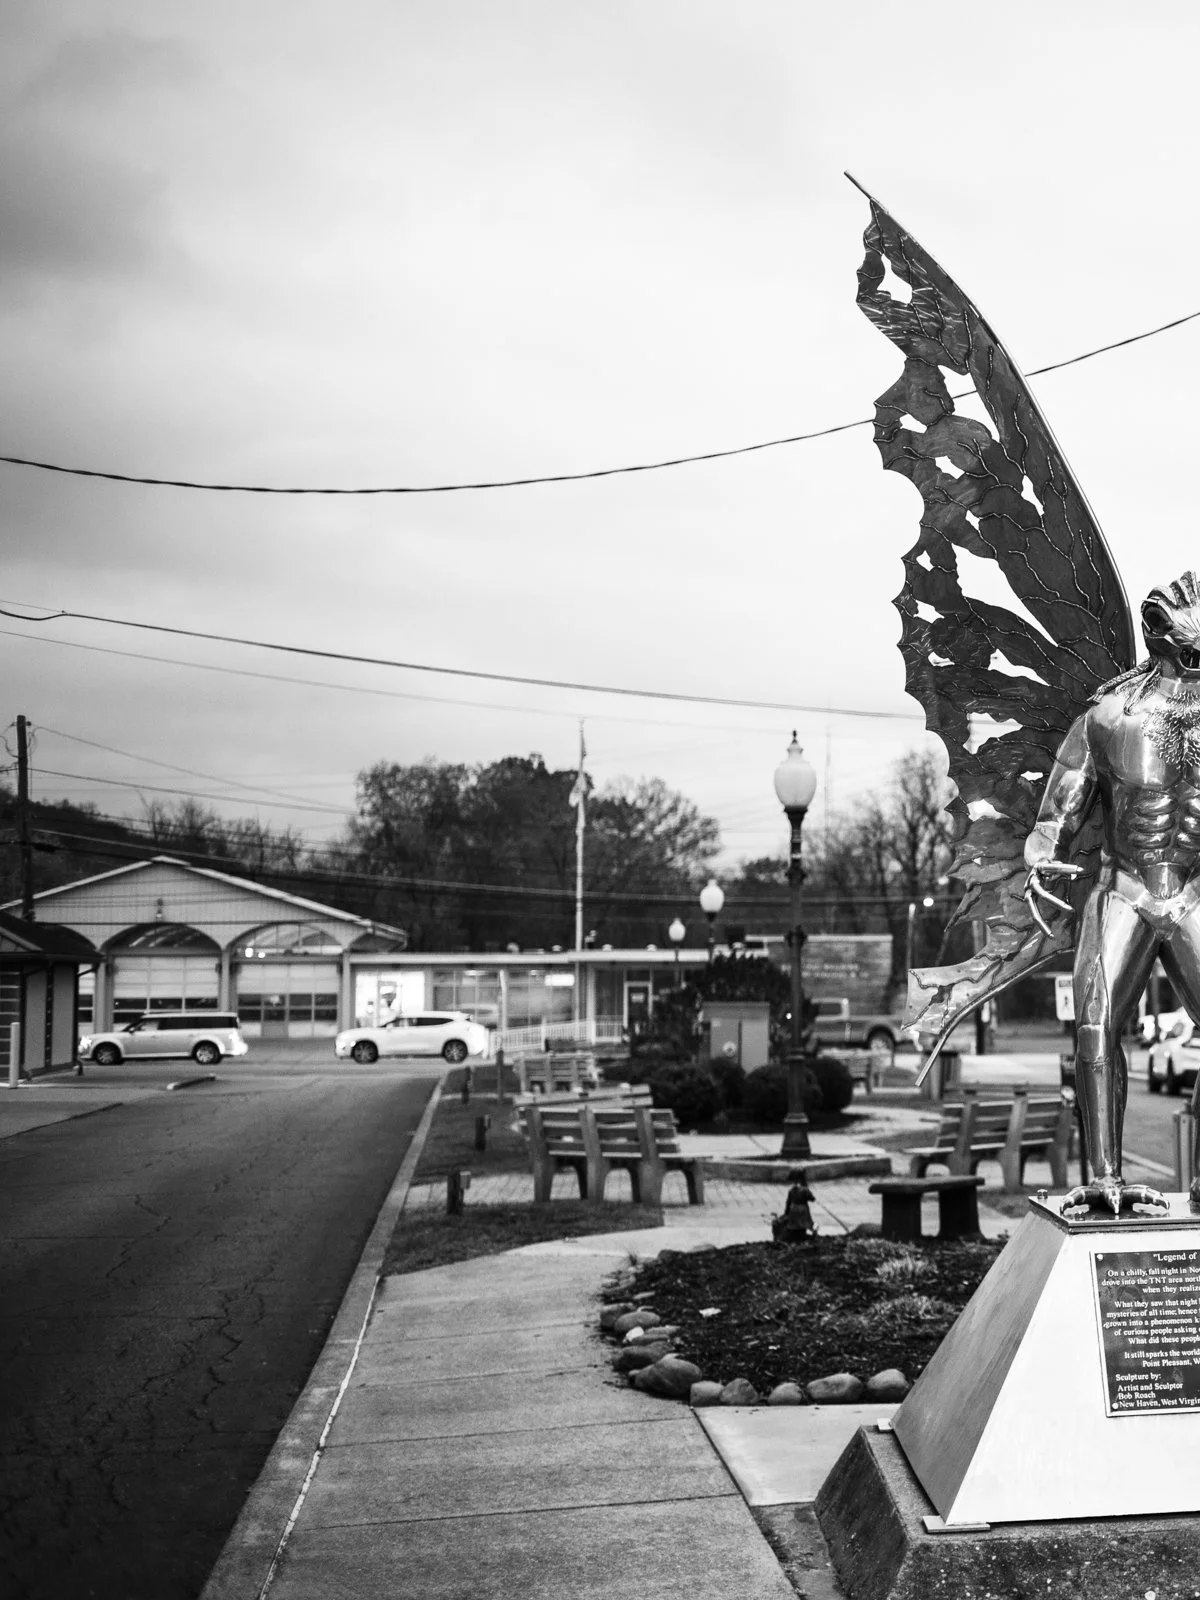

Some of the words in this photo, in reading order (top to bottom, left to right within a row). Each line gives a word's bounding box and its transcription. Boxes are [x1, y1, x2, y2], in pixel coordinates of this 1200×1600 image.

[1180, 1298, 1198, 1307] night
[1107, 1310, 1139, 1319] mysteries
[1151, 1318, 1192, 1327] phenomenon
[1151, 1327, 1172, 1336] people
[1146, 1350, 1168, 1359] sparks
[1116, 1374, 1149, 1382] Sculpture
[1155, 1382, 1183, 1391] Sculptor
